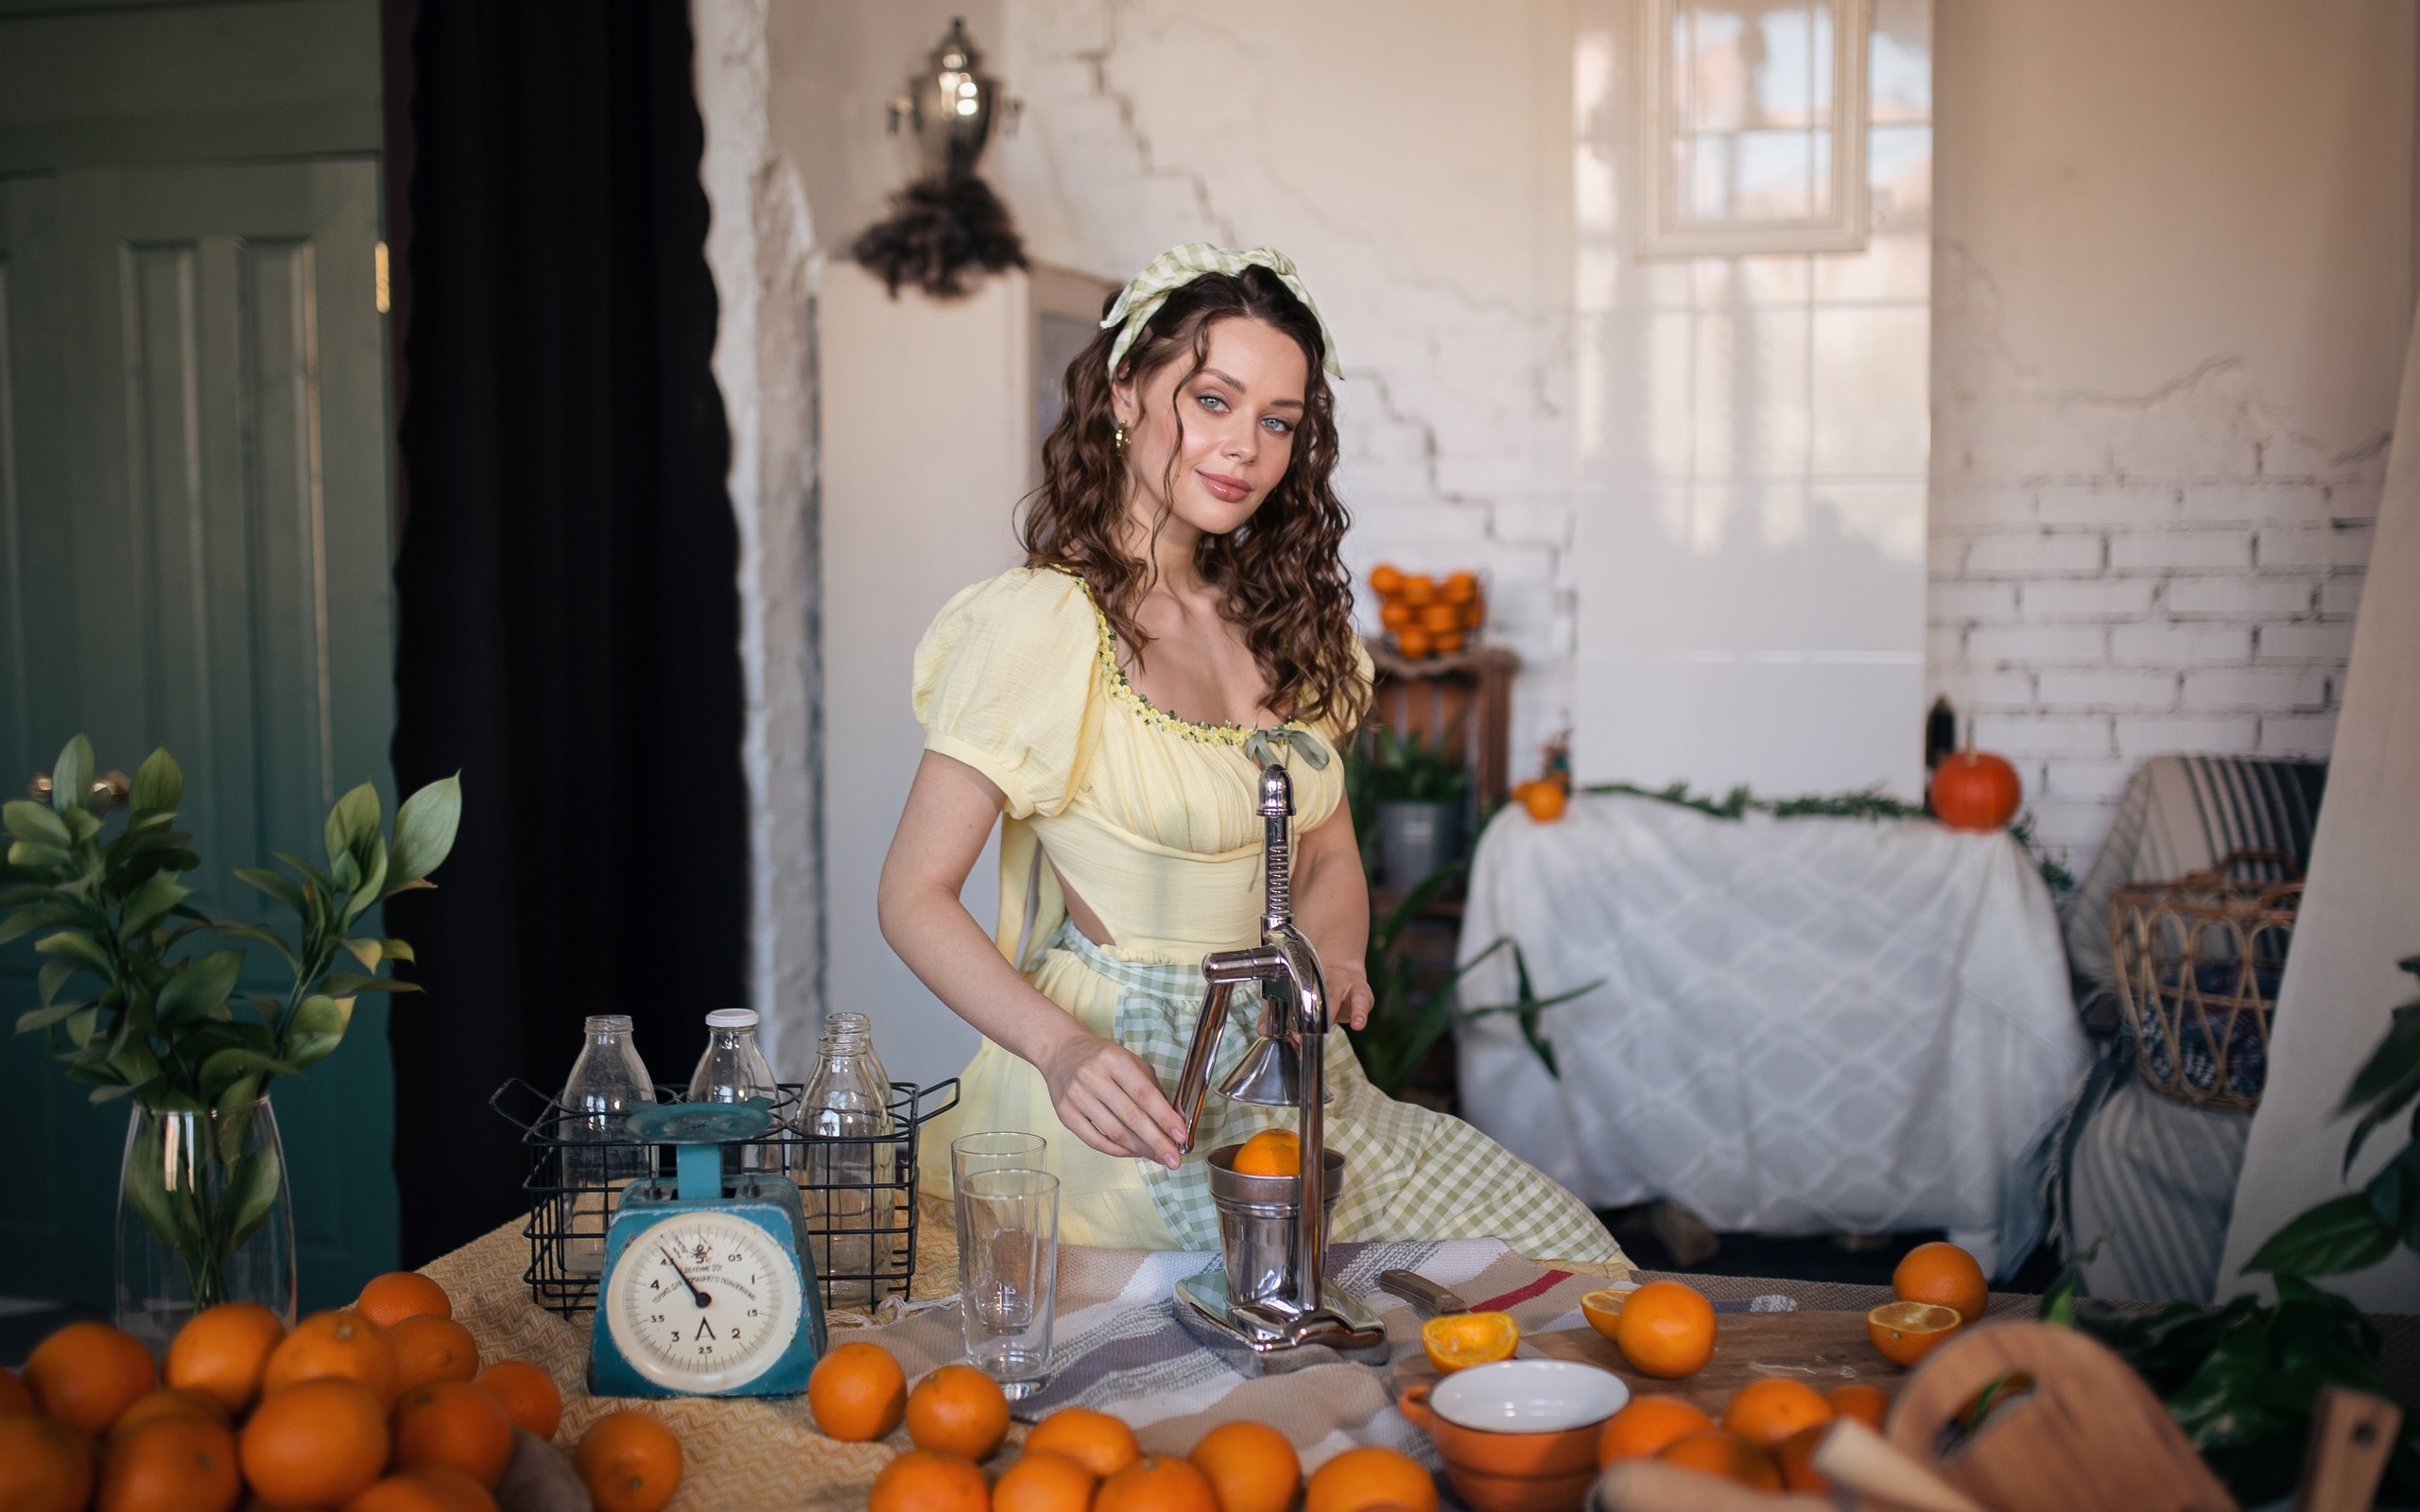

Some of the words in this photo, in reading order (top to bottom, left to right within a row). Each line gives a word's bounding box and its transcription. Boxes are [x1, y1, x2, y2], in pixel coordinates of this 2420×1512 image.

[752, 1273, 755, 1285] 1
[649, 1280, 660, 1291] 4
[671, 1332, 680, 1342] 3
[732, 1328, 741, 1339] 2
